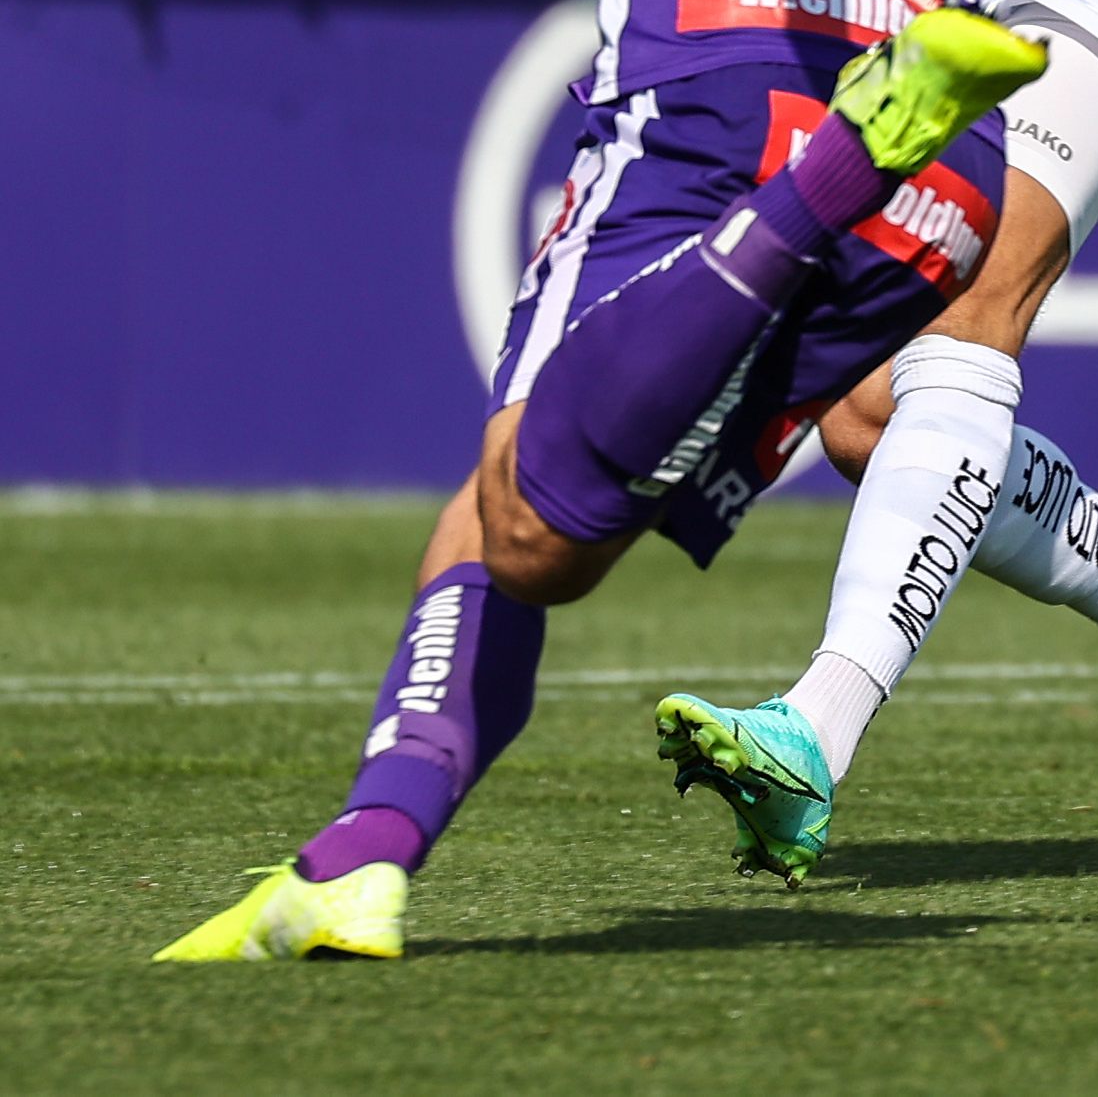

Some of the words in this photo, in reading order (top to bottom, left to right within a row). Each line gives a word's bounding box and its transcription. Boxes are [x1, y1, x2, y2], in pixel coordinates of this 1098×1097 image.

[1007, 118, 1074, 162] JAKO
[888, 535, 959, 653] MOLTO
[933, 457, 1001, 552] LUCE
